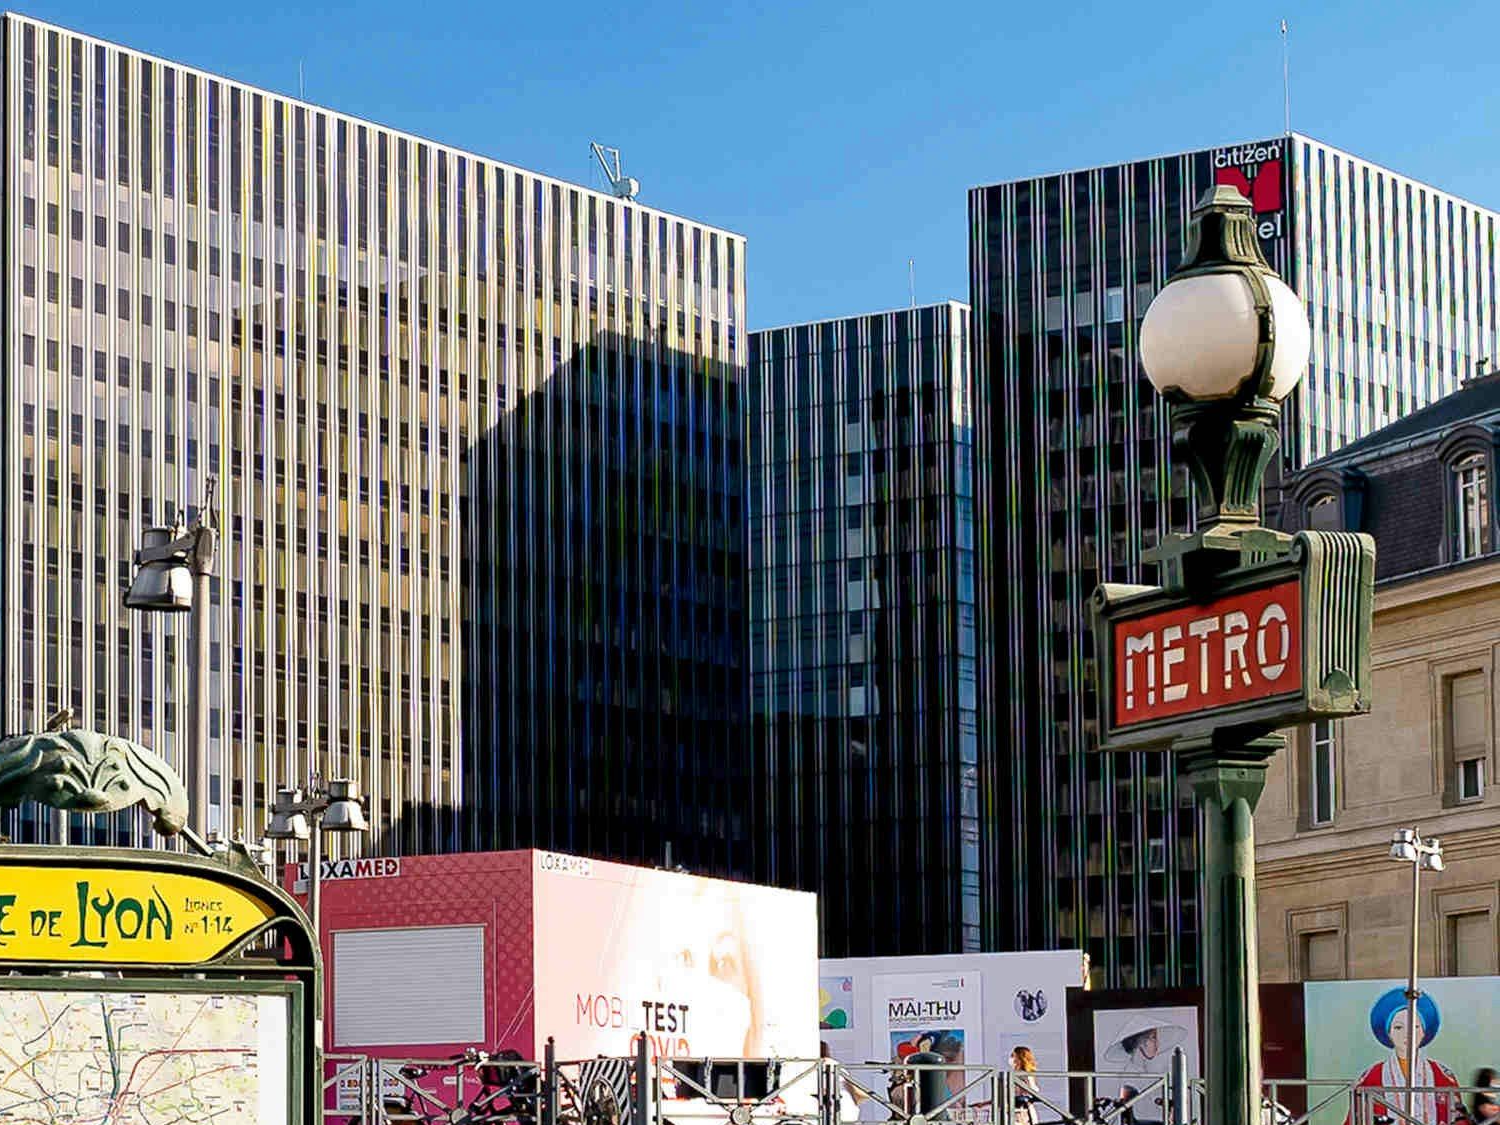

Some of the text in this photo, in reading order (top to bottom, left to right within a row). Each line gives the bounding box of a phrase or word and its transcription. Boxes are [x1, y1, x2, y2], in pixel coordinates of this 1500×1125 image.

[1214, 145, 1280, 168] citizen
[1126, 603, 1291, 709] METRO
[30, 910, 63, 937] DE
[70, 882, 173, 948] LYON
[642, 1000, 690, 1034] TEST
[888, 1000, 962, 1017] MAI-THU
